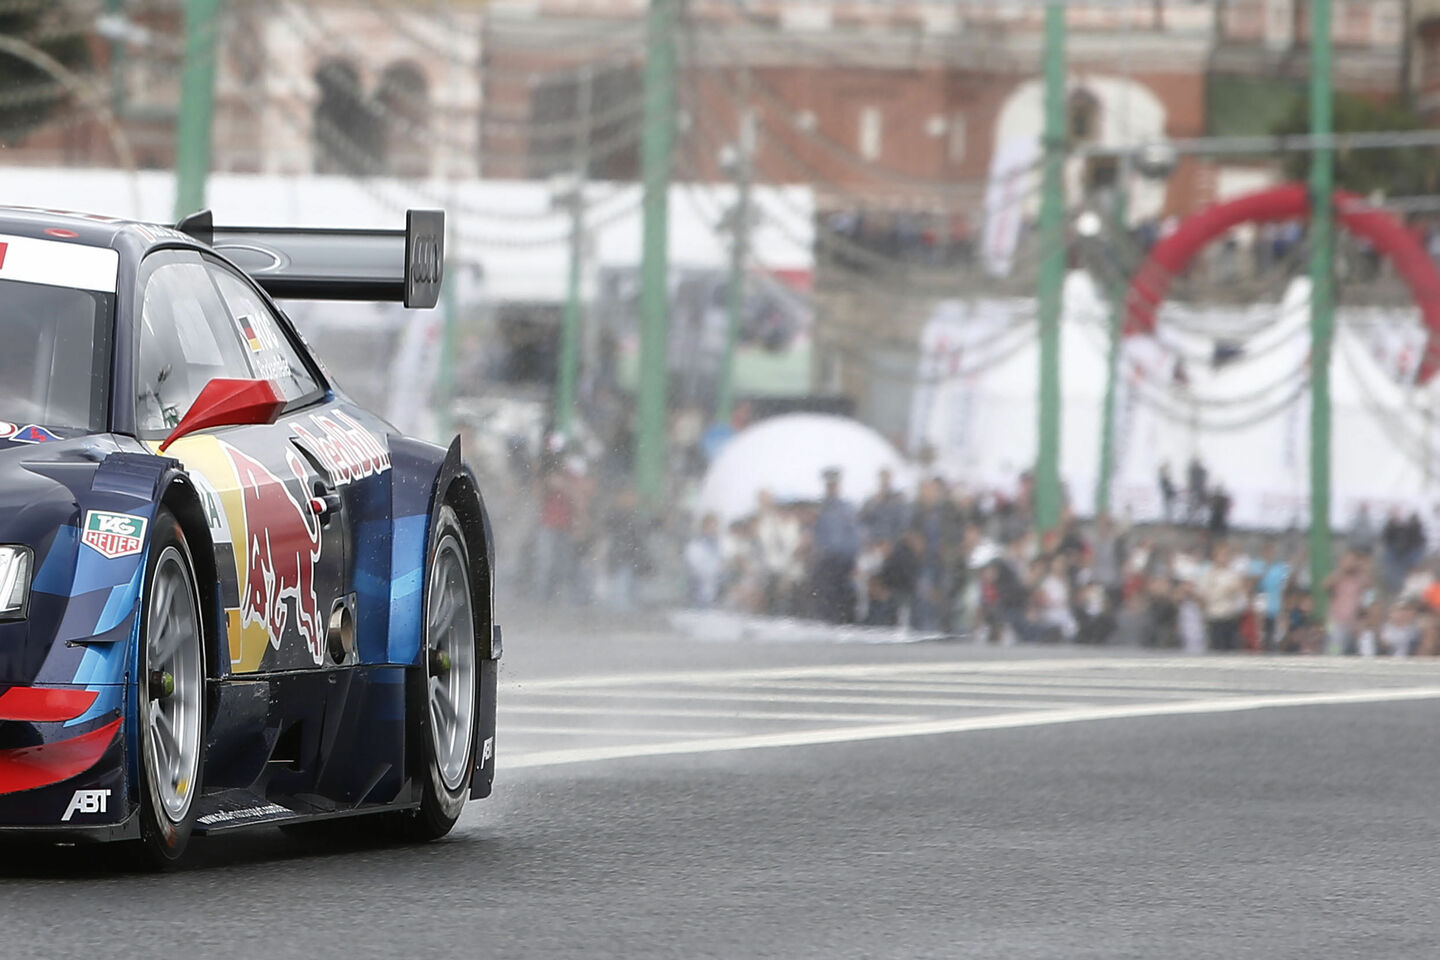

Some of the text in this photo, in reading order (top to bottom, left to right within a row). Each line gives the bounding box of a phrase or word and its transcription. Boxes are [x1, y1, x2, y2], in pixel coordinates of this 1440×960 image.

[97, 514, 136, 535] TAG
[87, 532, 138, 554] HEUER
[61, 789, 111, 821] ABT
